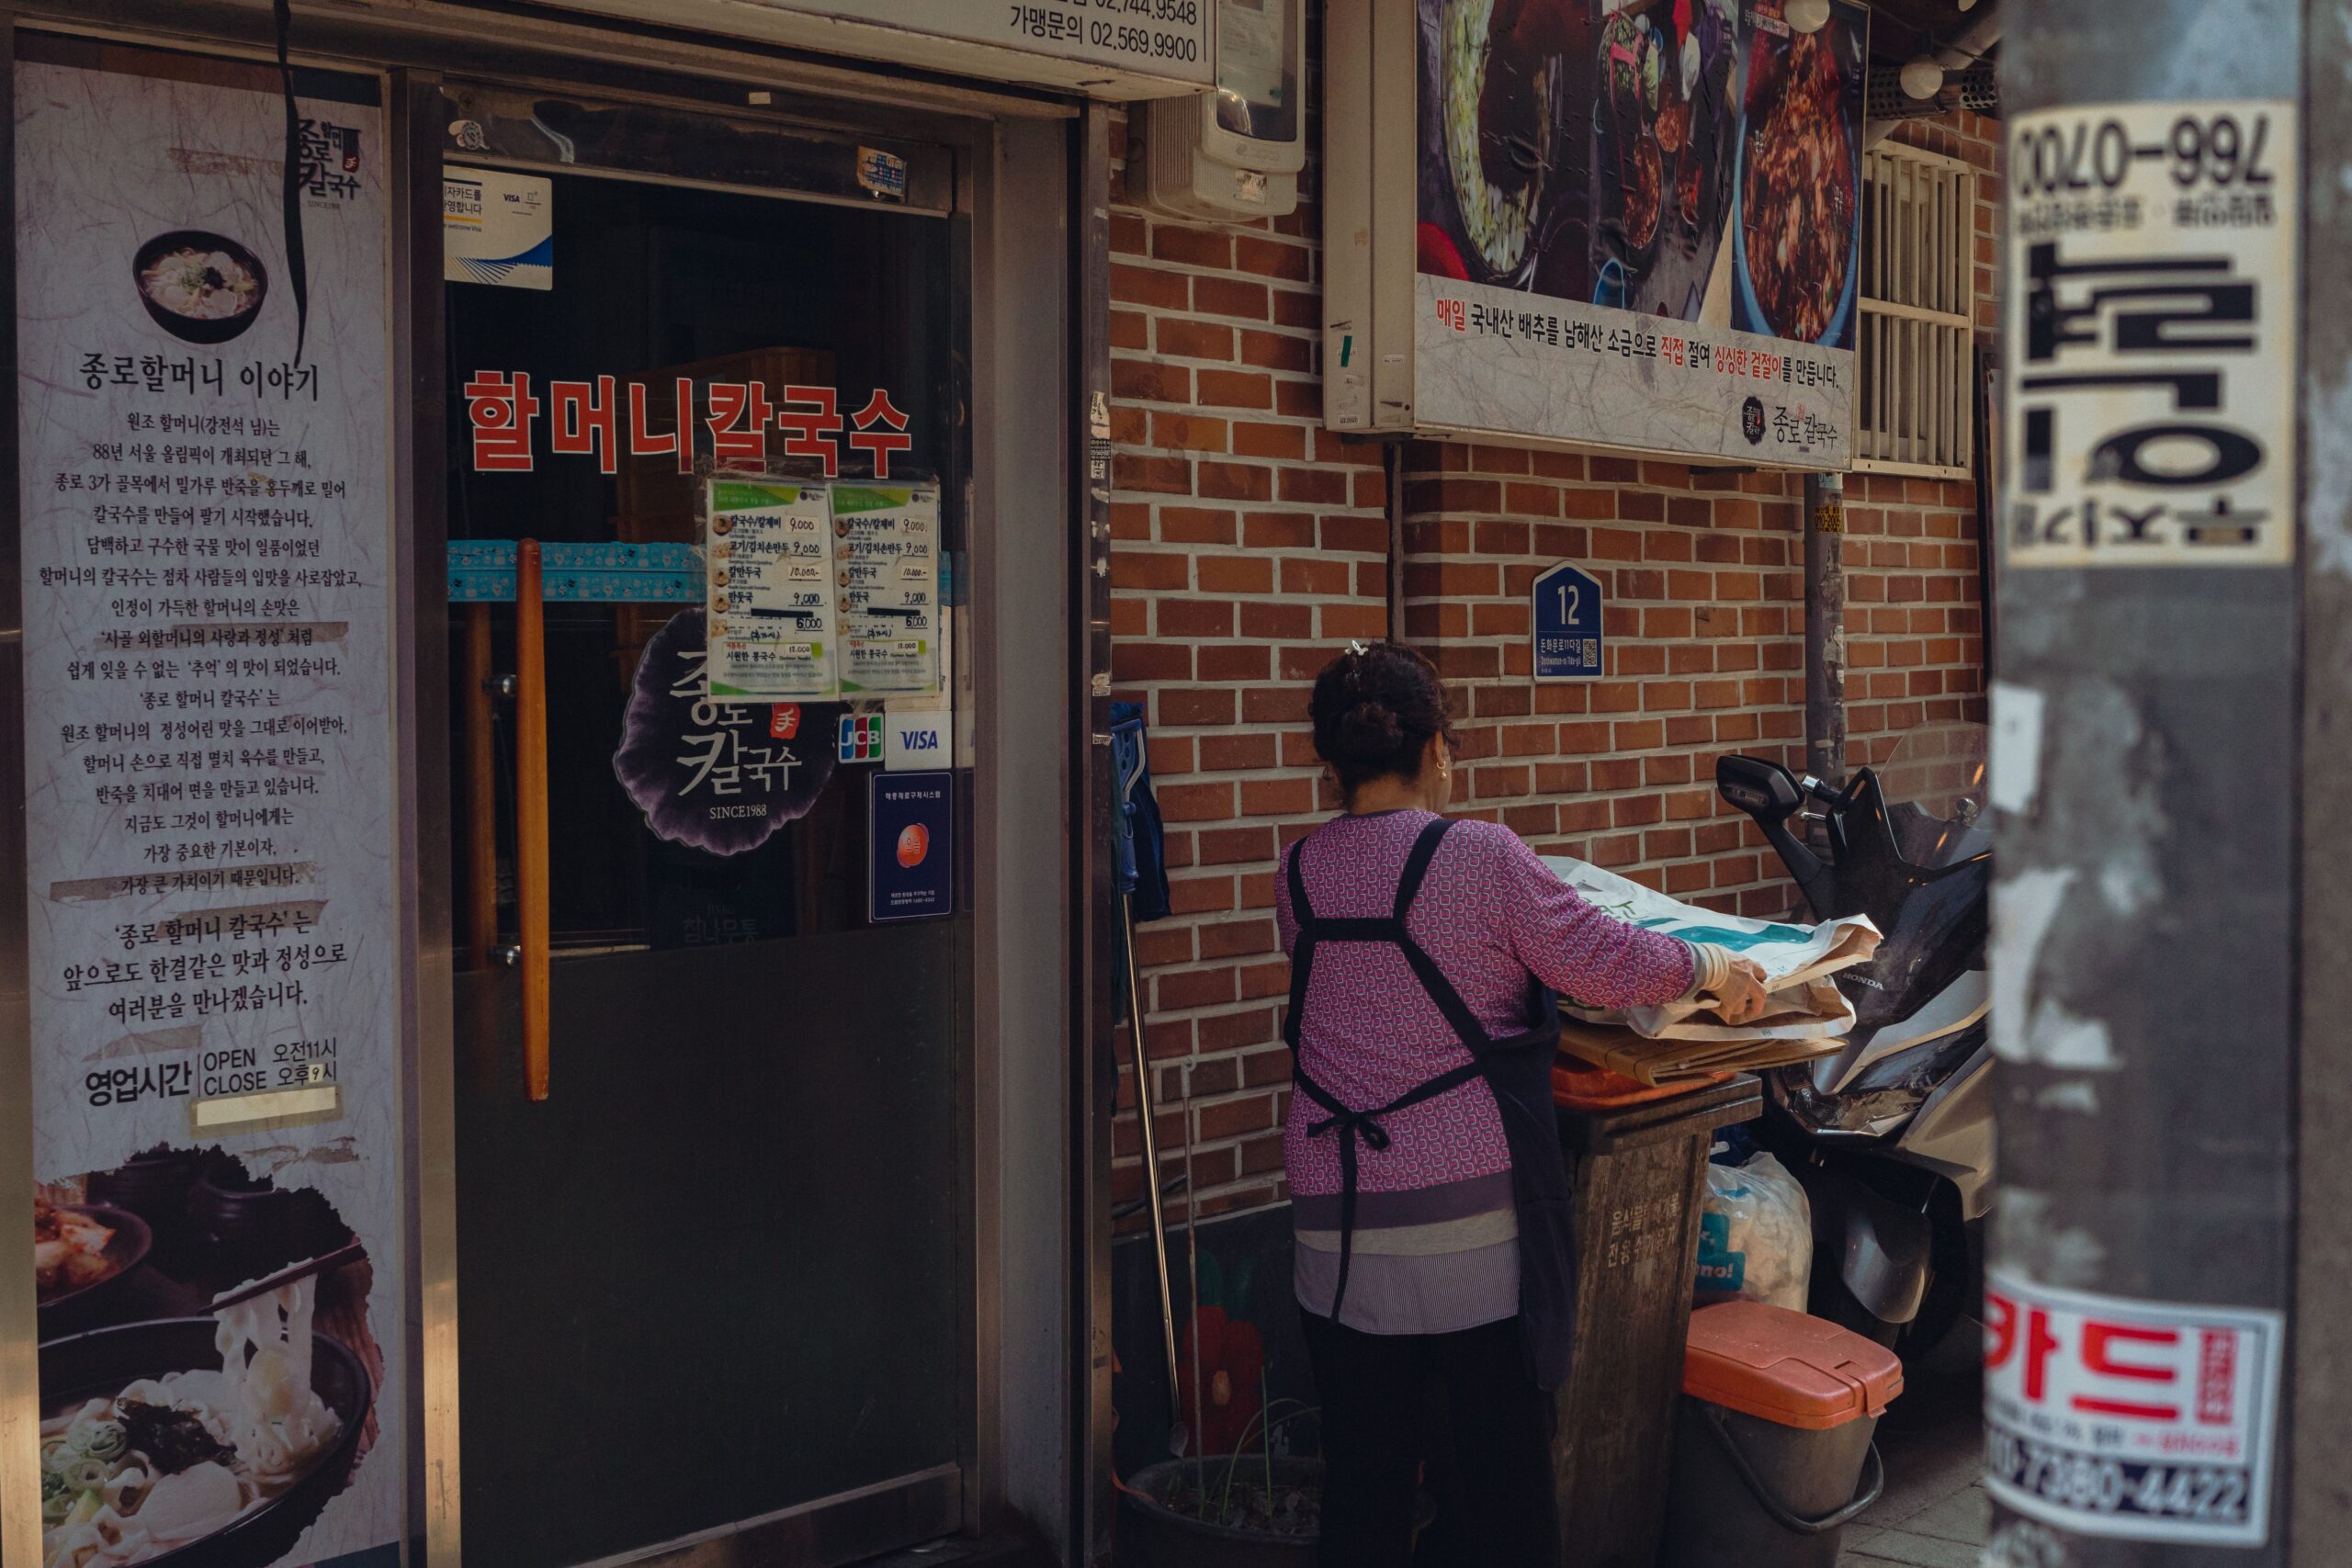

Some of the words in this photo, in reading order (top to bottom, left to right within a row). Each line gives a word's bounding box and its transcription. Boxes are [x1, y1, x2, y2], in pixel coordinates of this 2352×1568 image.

[1011, 6, 1082, 44] 가맹문의
[1091, 21, 1196, 62] 02.569.9900
[298, 162, 361, 200] 칼국수
[503, 194, 520, 202] VISA
[1437, 299, 1465, 332] 매일
[1471, 304, 1513, 336] 국내산
[1519, 312, 1558, 347] 배추를
[1565, 320, 1602, 353] 남해산
[1608, 330, 1657, 359] 소금으로
[1662, 336, 1684, 366] 직접
[1689, 340, 1711, 368] 절여
[1714, 345, 1747, 376] 싱싱한
[1751, 352, 1792, 382] 겉절이를
[1796, 359, 1838, 389] 만듭니다.
[80, 353, 222, 396] 종로할머니
[241, 361, 319, 401] 이야기
[128, 412, 155, 431] 원조
[160, 414, 244, 435] 할머니(강전석
[251, 419, 279, 437] 님)는
[464, 370, 911, 479] 할머니칼국수
[1773, 406, 1801, 443] 종로
[1804, 413, 1838, 449] 칼국수
[93, 443, 123, 461] 88년
[129, 445, 155, 463] 서울
[164, 446, 214, 465] 올림픽이
[220, 447, 271, 467] 개최되던
[277, 451, 290, 464] 그
[55, 473, 84, 491] 종로
[88, 474, 110, 492] 3가
[116, 475, 170, 494] 골목에서
[176, 478, 215, 494] 밀가루
[222, 478, 261, 497] 반죽을
[265, 479, 316, 497] 홍두깨로
[322, 480, 346, 498] 밀어
[94, 506, 149, 525] 칼국수를
[154, 507, 194, 525] 만들어
[201, 508, 225, 526] 팔기
[232, 508, 312, 528] 시작했습니다.
[87, 537, 142, 555] 담백하고
[148, 537, 188, 555] 구수한
[194, 538, 220, 555] 국물
[225, 539, 250, 556] 맛이
[256, 539, 319, 558] 일품이었던
[40, 567, 96, 586] 할머니의
[102, 568, 157, 586] 칼국수는
[163, 569, 188, 586] 점차
[194, 569, 246, 587] 사람들의
[253, 569, 289, 588] 입맛을
[295, 570, 362, 588] 사로잡았고,
[111, 600, 153, 617] 인정이
[158, 600, 198, 617] 가득한
[204, 600, 255, 617] 할머니의
[262, 600, 300, 617] 손맛은
[1558, 585, 1579, 625] 12
[139, 630, 205, 649] 외할머니의
[210, 629, 249, 648] 사랑과
[288, 629, 312, 647] 처럼
[727, 652, 749, 661] 시원한
[752, 652, 775, 661] 콩국수
[850, 649, 866, 659] 시원한
[67, 662, 95, 681] 쉽게
[101, 662, 127, 680] 잊을
[133, 662, 148, 680] 수
[153, 662, 180, 679] 없는
[226, 661, 241, 679] 의
[243, 661, 268, 678] 맛이
[275, 660, 340, 677] 되었습니다.
[175, 691, 215, 709] 할머니
[267, 690, 280, 707] 는
[62, 725, 90, 743] 원조
[96, 723, 150, 742] 할머니의
[161, 720, 213, 740] 정성어린
[220, 720, 245, 739] 맛을
[250, 719, 289, 736] 그대로
[842, 729, 880, 747] JCB
[900, 731, 938, 750] VISA
[84, 754, 124, 773] 할머니
[130, 753, 172, 771] 손으로
[176, 752, 203, 770] 직접
[209, 750, 233, 768] 멸치
[240, 750, 278, 767] 육수를
[283, 748, 323, 765] 만들고,
[676, 729, 802, 796] 칼국수
[96, 786, 137, 805] 반죽을
[143, 784, 182, 802] 치대어
[189, 782, 215, 800] 면을
[220, 780, 260, 798] 만들고
[265, 777, 319, 796] 있습니다.
[125, 814, 166, 833] 지금도
[171, 812, 209, 831] 그것이
[216, 808, 294, 828] 할머니에게는
[709, 804, 767, 819] SINCE1988
[144, 845, 167, 863] 가장
[176, 842, 215, 861] 중요한
[122, 876, 148, 895] 가장
[154, 876, 166, 894] 큰
[173, 871, 225, 893] 가치이기
[231, 867, 300, 890] 때문입니다.
[165, 919, 220, 946] 할머니
[294, 910, 311, 934] 는
[64, 963, 142, 992] 앞으로도
[150, 954, 226, 984] 한결같은
[232, 952, 269, 976] 맛과
[276, 943, 346, 969] 정성으로
[1843, 973, 1883, 990] HONDA
[109, 991, 186, 1024] 여러분을
[193, 981, 308, 1016] 만나겠습니다.
[85, 1061, 192, 1107] 영업시간
[204, 1047, 255, 1072] OPEN
[273, 1037, 337, 1064] 오전11시
[204, 1071, 267, 1096] CLOSE
